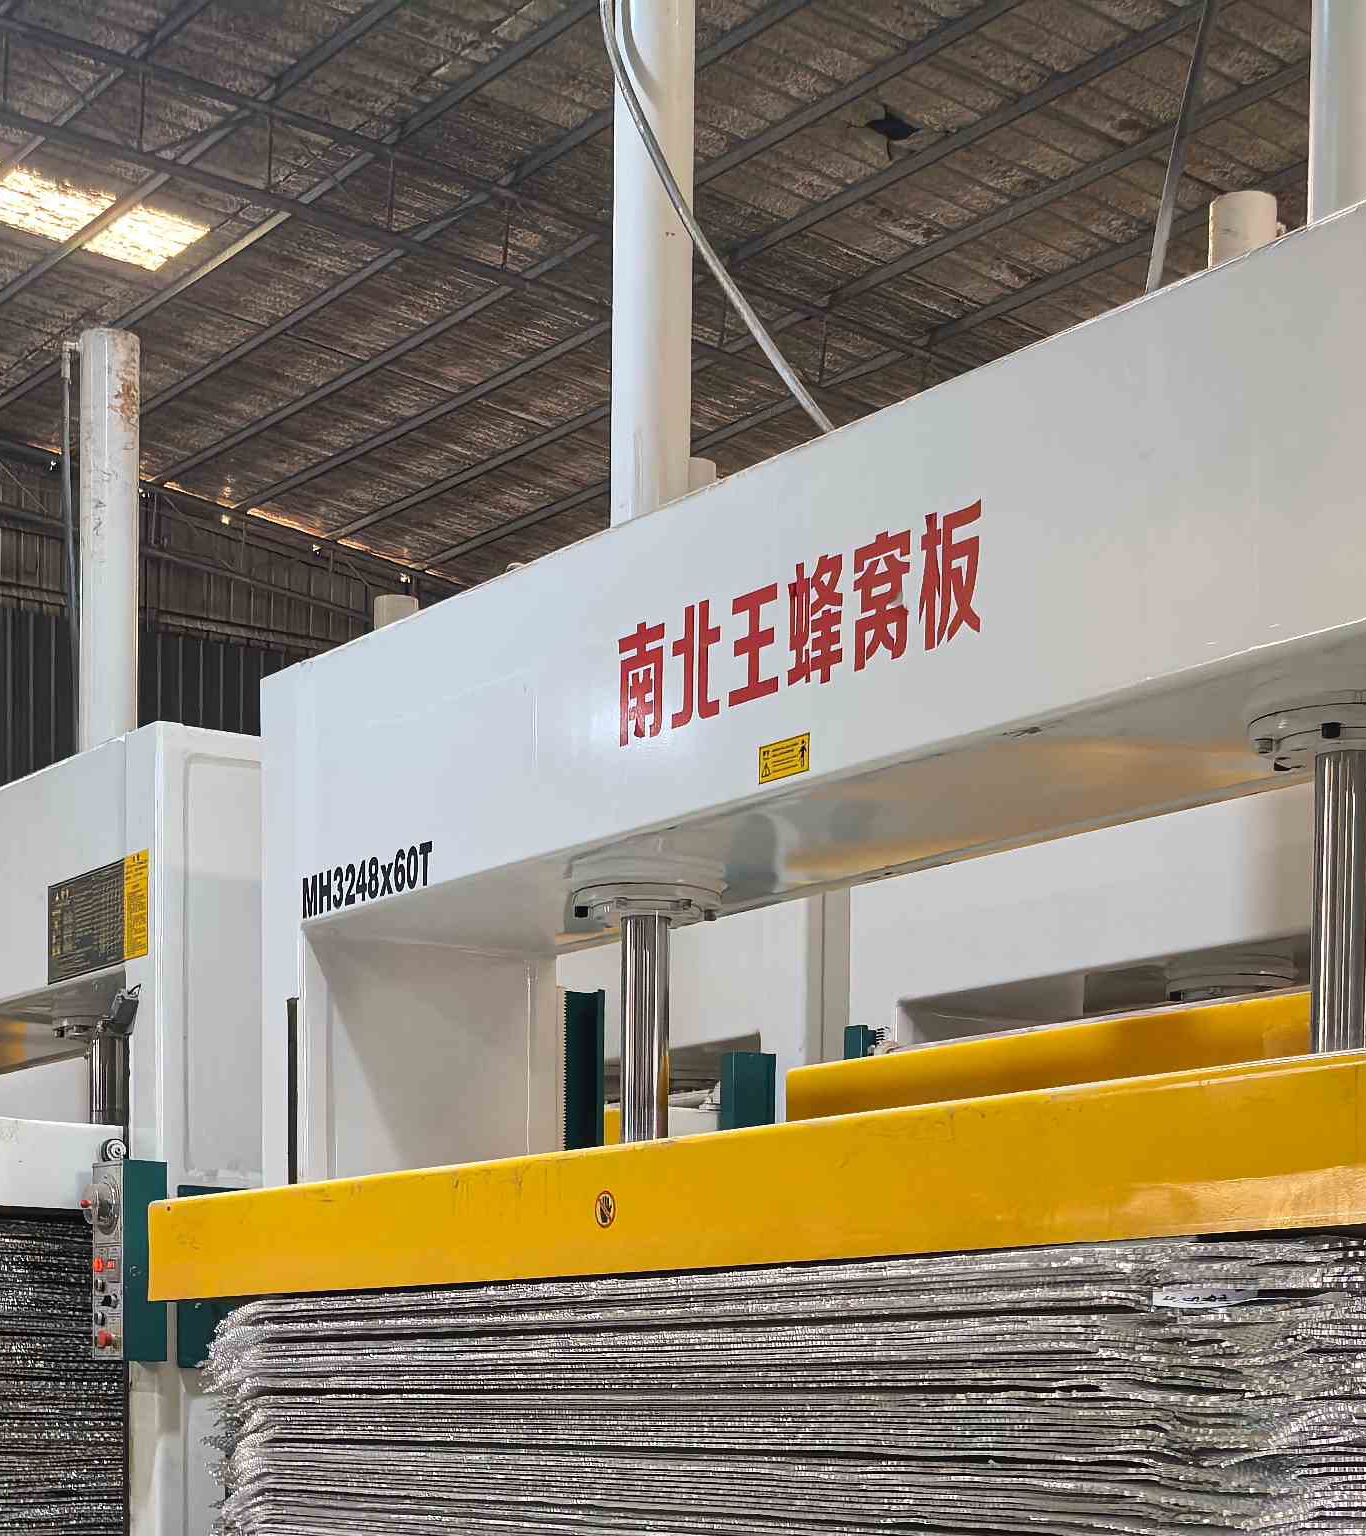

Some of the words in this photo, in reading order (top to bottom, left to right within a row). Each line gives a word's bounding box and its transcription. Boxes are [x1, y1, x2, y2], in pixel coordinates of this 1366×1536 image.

[618, 498, 982, 747] 南北王蜂窝板
[302, 840, 434, 919] MH3248x60T
